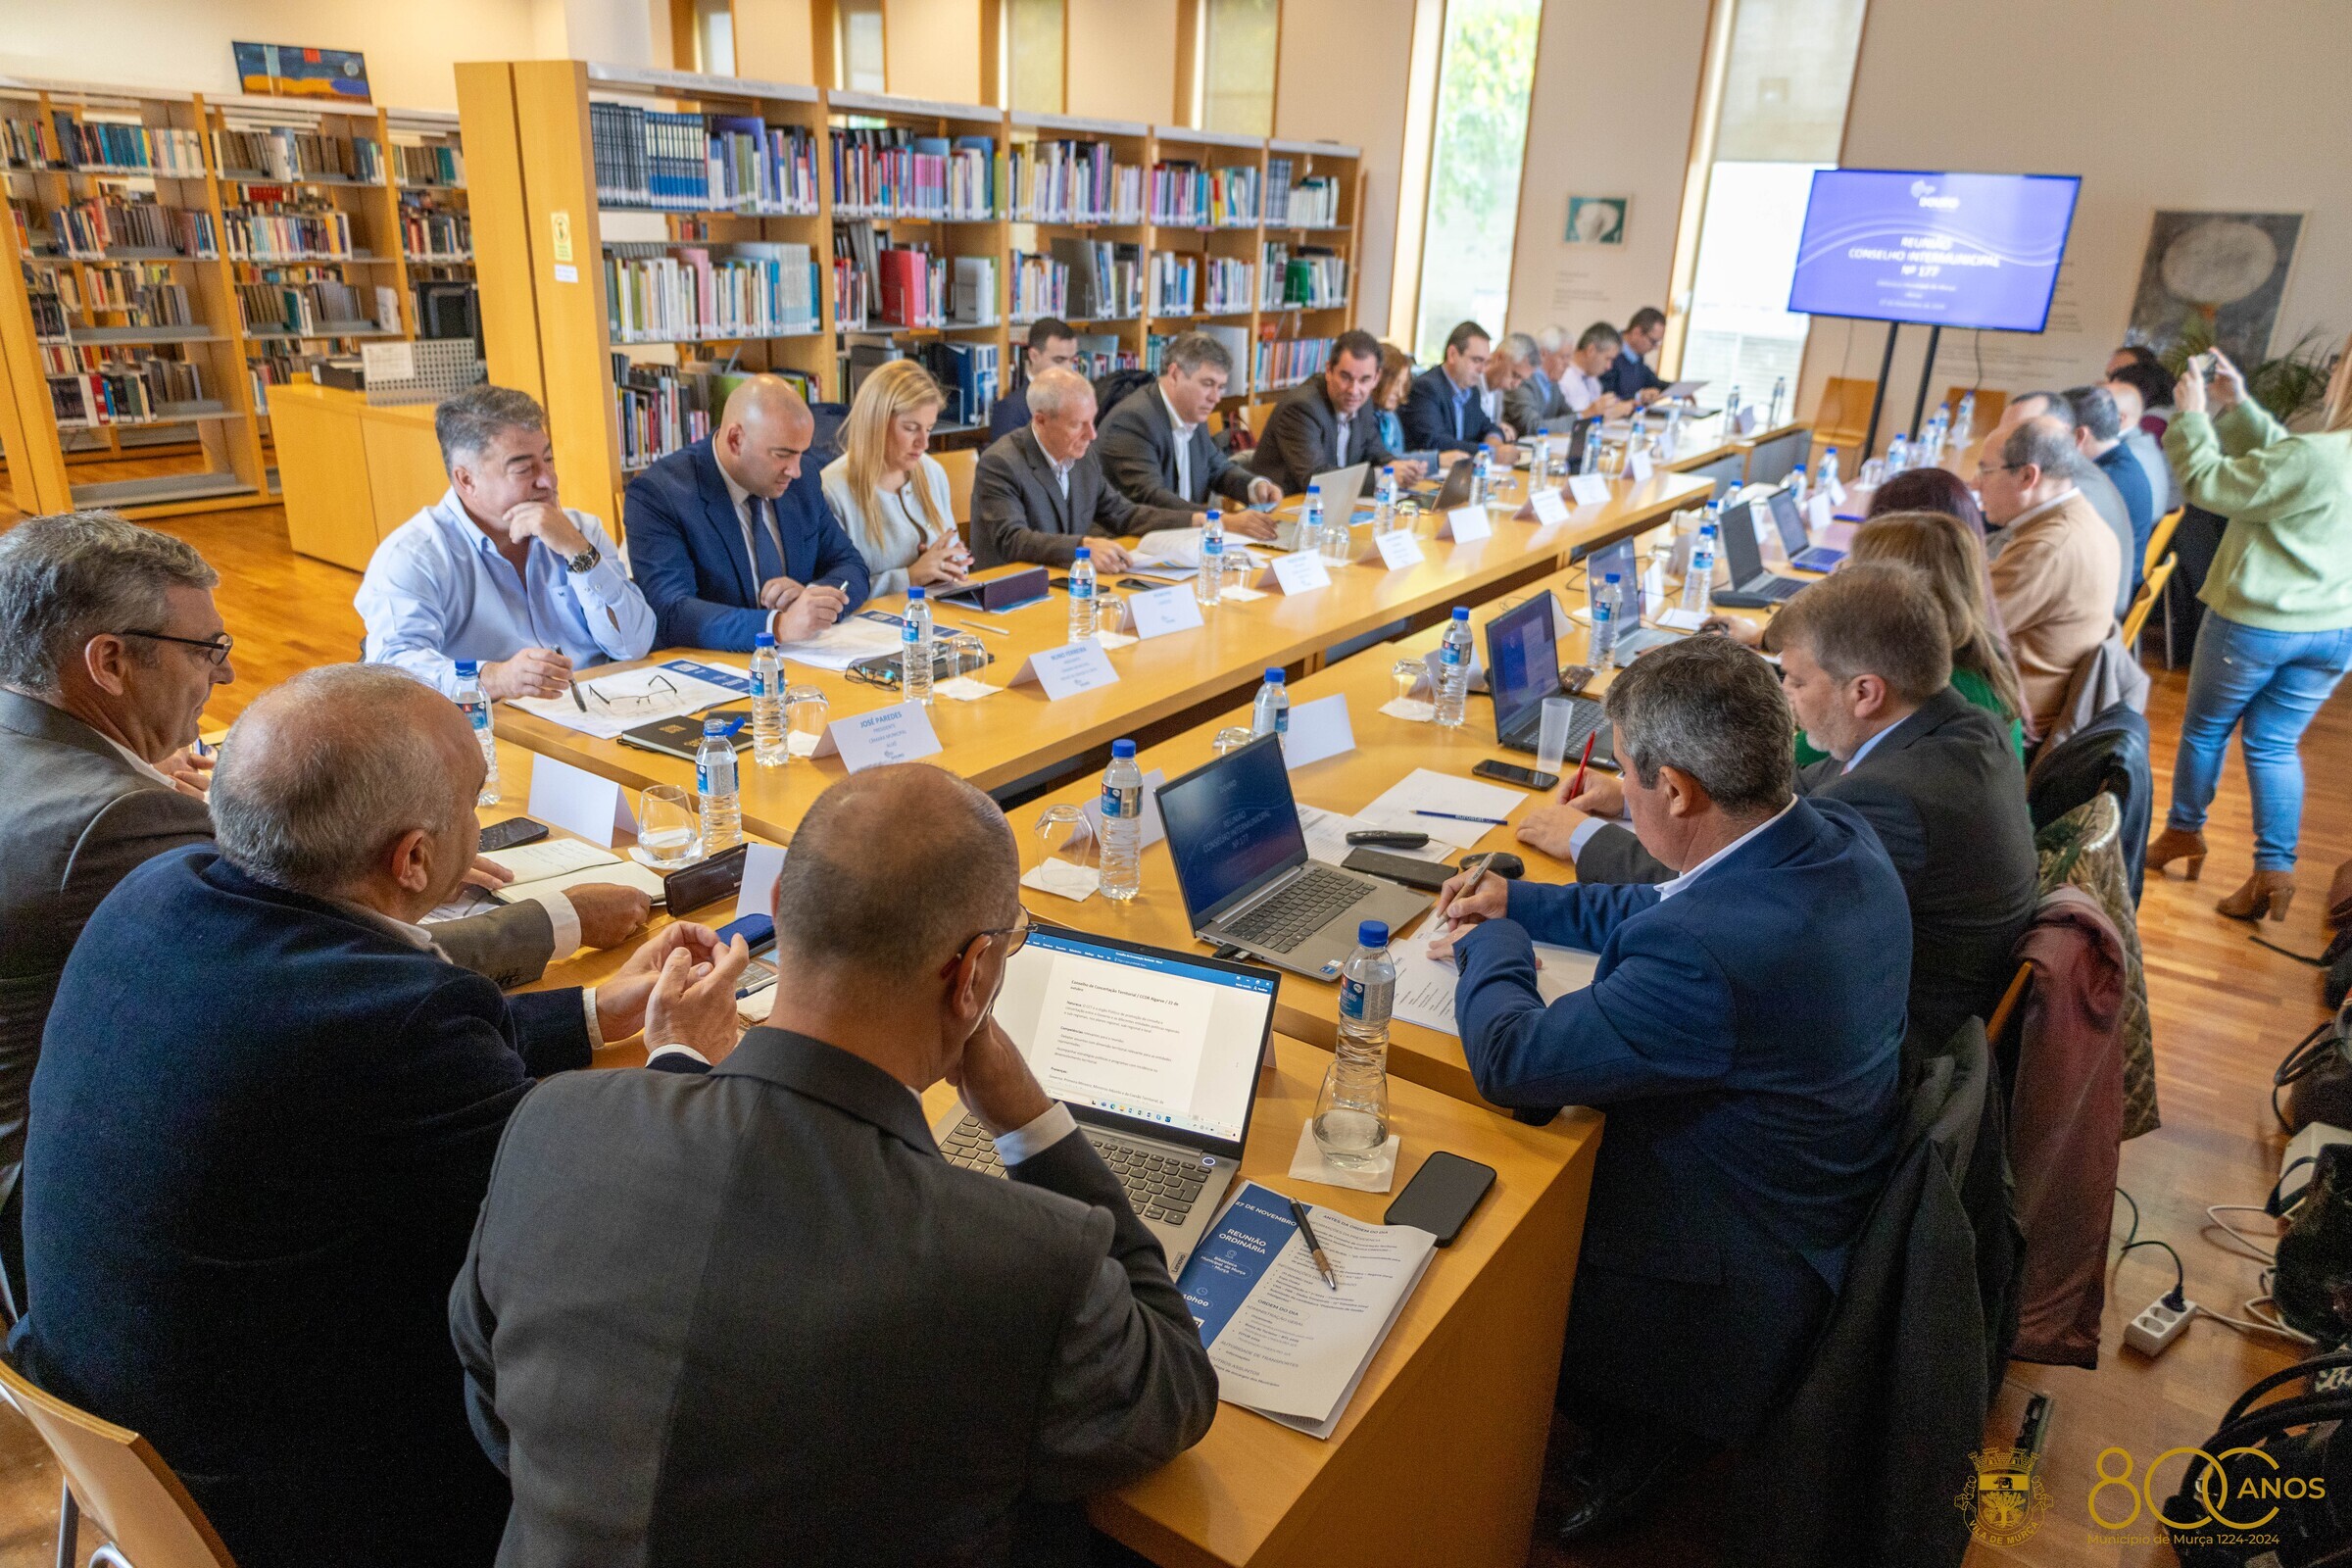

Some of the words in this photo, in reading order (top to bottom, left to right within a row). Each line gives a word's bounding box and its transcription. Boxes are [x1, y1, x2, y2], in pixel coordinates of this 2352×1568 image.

[1848, 248, 1906, 262] CONSELHO
[1907, 251, 2000, 268] INTERMUNICIPAL
[860, 717, 874, 728] JOSÉ
[875, 711, 902, 724] PAREDES
[1094, 985, 1117, 994] Concertação
[1254, 1207, 1298, 1227] NOVEMBRO
[1349, 1224, 1370, 1233] ORDEM
[1217, 1233, 1267, 1254] ORDINÁRIA
[1227, 1228, 1268, 1248] REUNIÃO
[1171, 1254, 1186, 1273] Lenovo
[1214, 1265, 1231, 1274] Murça
[1231, 1266, 1248, 1276] Murça
[1257, 1299, 1279, 1309] ORDEM
